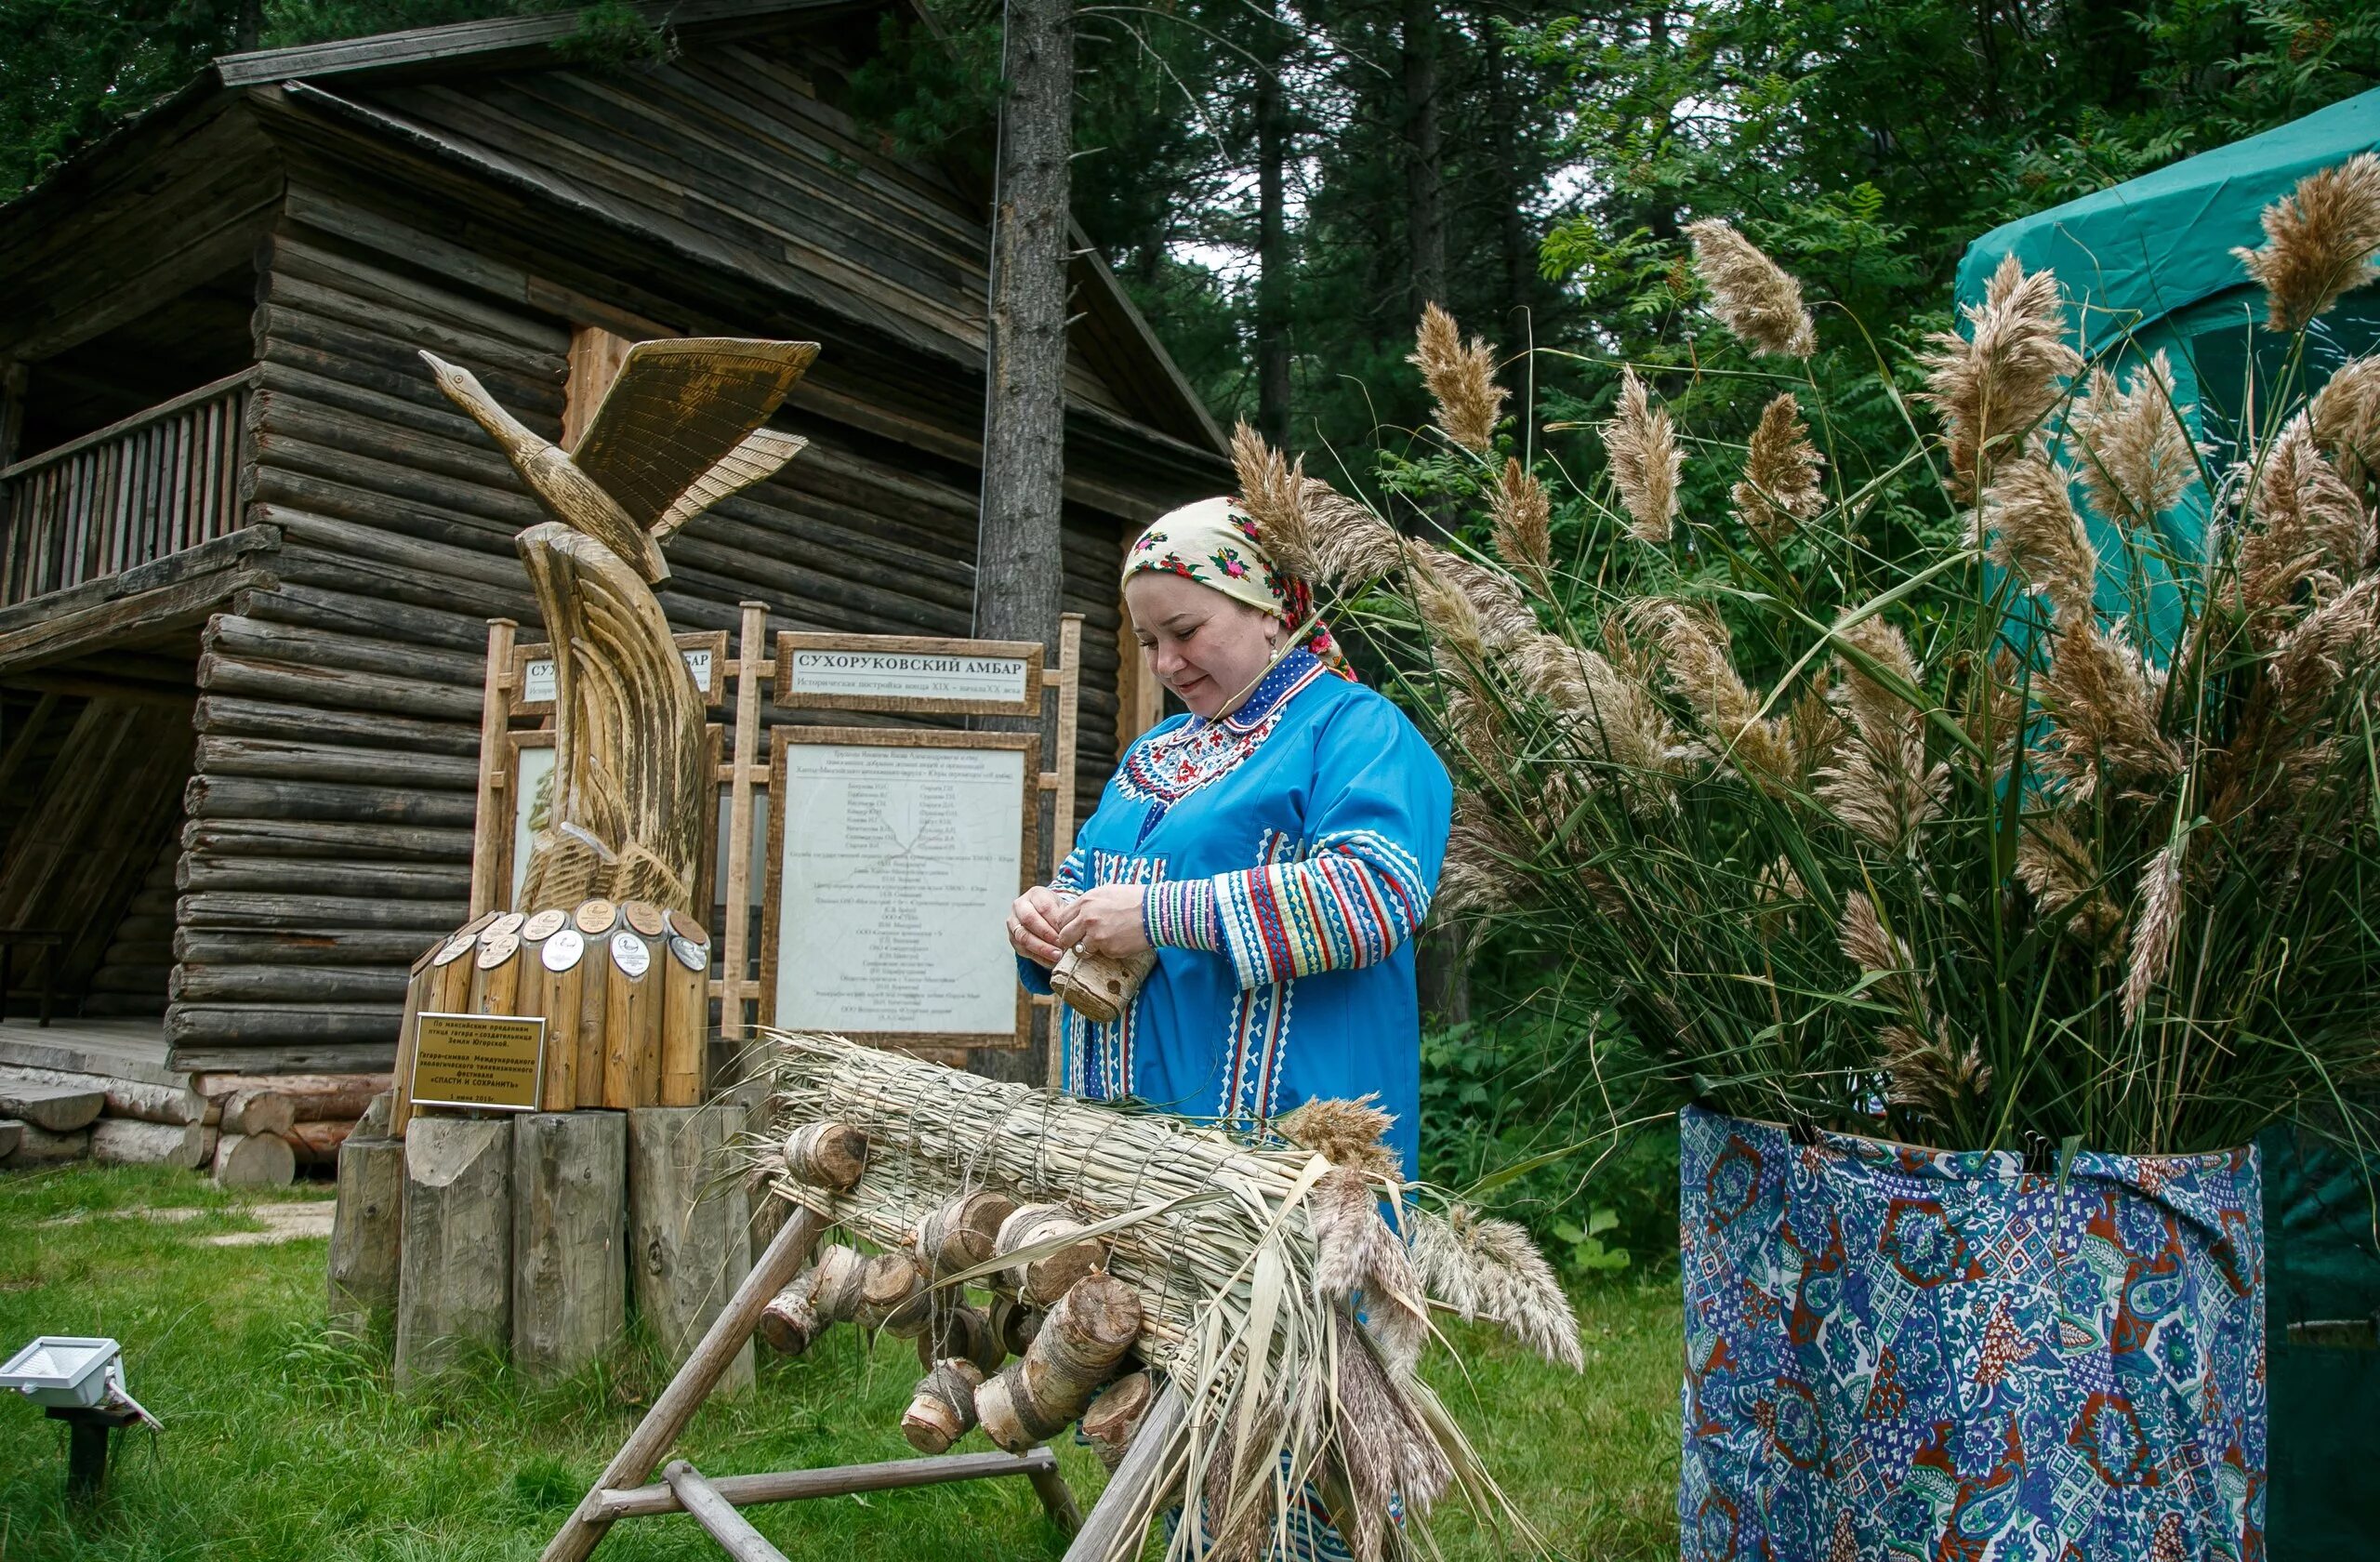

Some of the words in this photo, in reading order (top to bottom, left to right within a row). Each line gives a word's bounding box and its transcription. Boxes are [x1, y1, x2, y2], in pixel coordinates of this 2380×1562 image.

[799, 655, 960, 672] СУХОРУКОВСКИЙ
[965, 662, 1023, 675] АМБАР
[445, 1022, 487, 1030] мансийским
[480, 1032, 533, 1040] создательница
[448, 1037, 470, 1045] Земли
[472, 1039, 509, 1047] Югорской.
[474, 1054, 536, 1066] Международного
[420, 1060, 474, 1070] экологического
[476, 1065, 533, 1073] телевизионного
[456, 1070, 494, 1079] фестиваля
[430, 1076, 463, 1084] «СПАСТИ
[472, 1079, 519, 1088] СОХРАНИТЬ»
